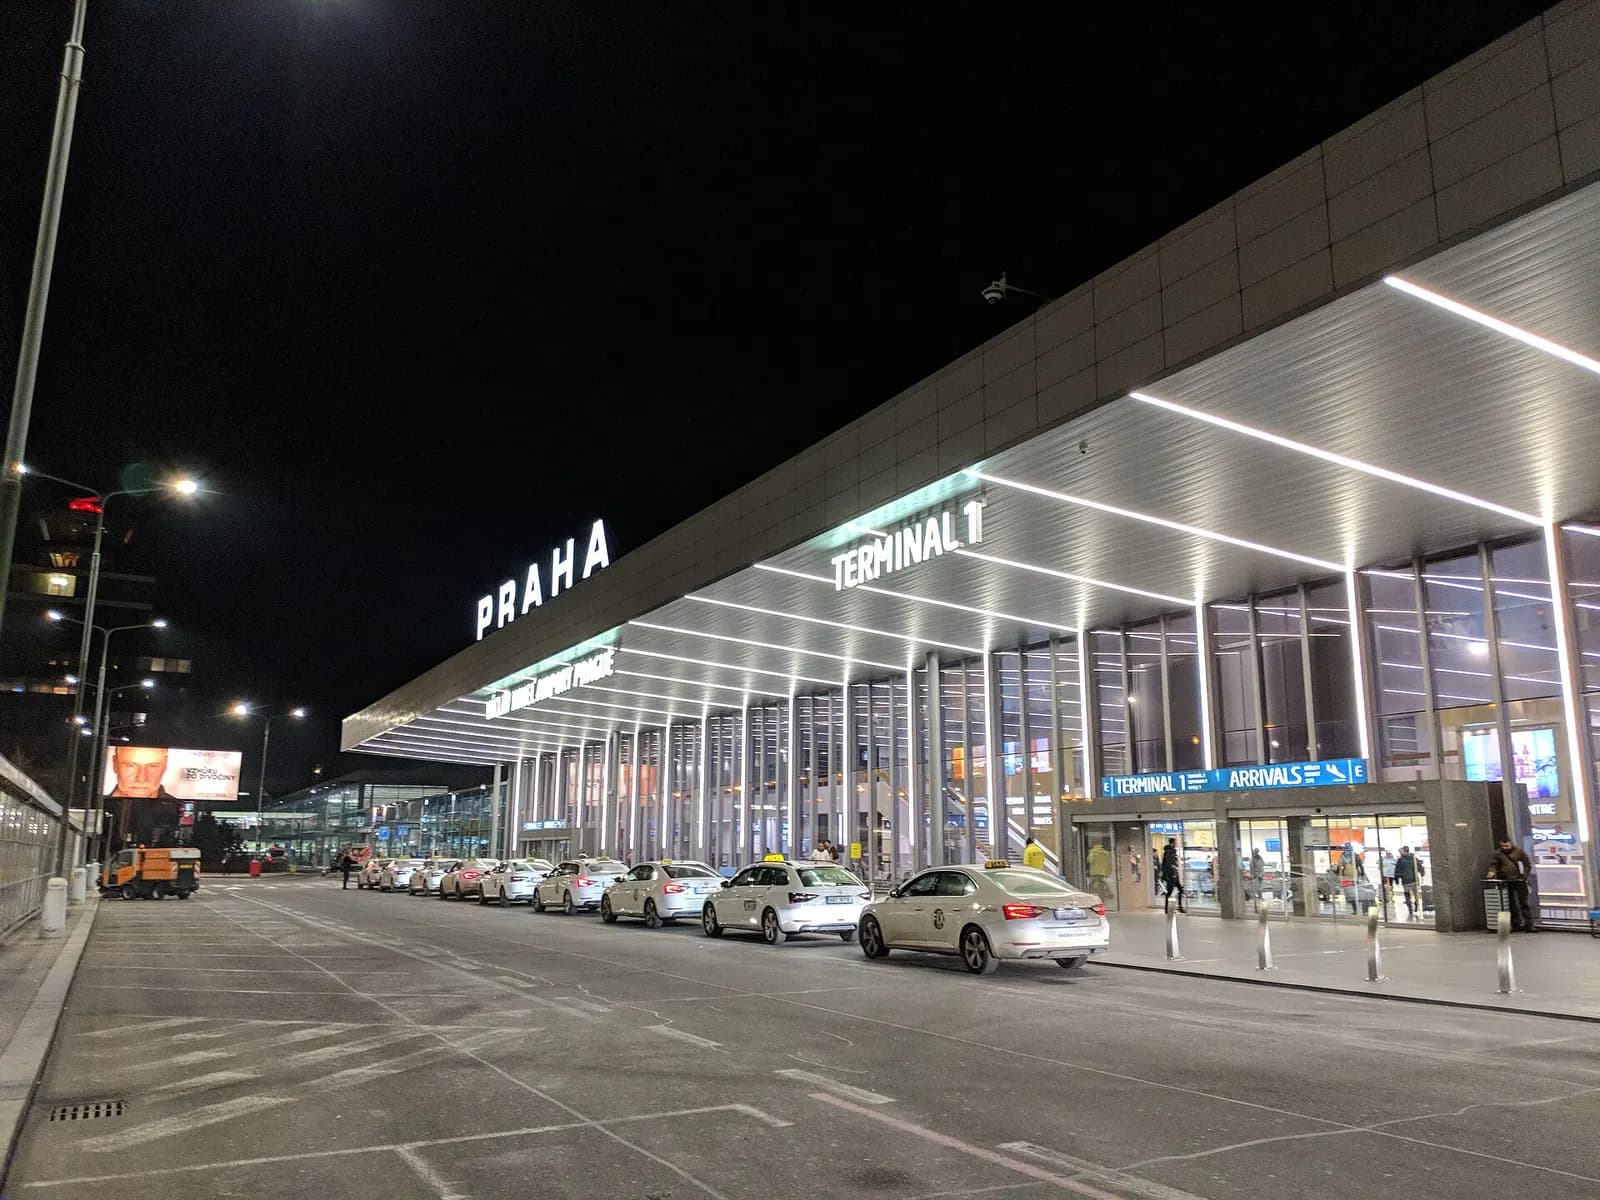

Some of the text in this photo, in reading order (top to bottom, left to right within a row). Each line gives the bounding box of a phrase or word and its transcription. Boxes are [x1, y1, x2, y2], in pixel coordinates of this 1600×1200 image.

[831, 500, 984, 591] TERMINAL 1
[476, 518, 610, 641] PRAHA
[1229, 765, 1303, 788] ARRIVALS
[1355, 765, 1363, 777] E
[1115, 775, 1177, 795] TERMINAL
[1179, 774, 1186, 791] 1
